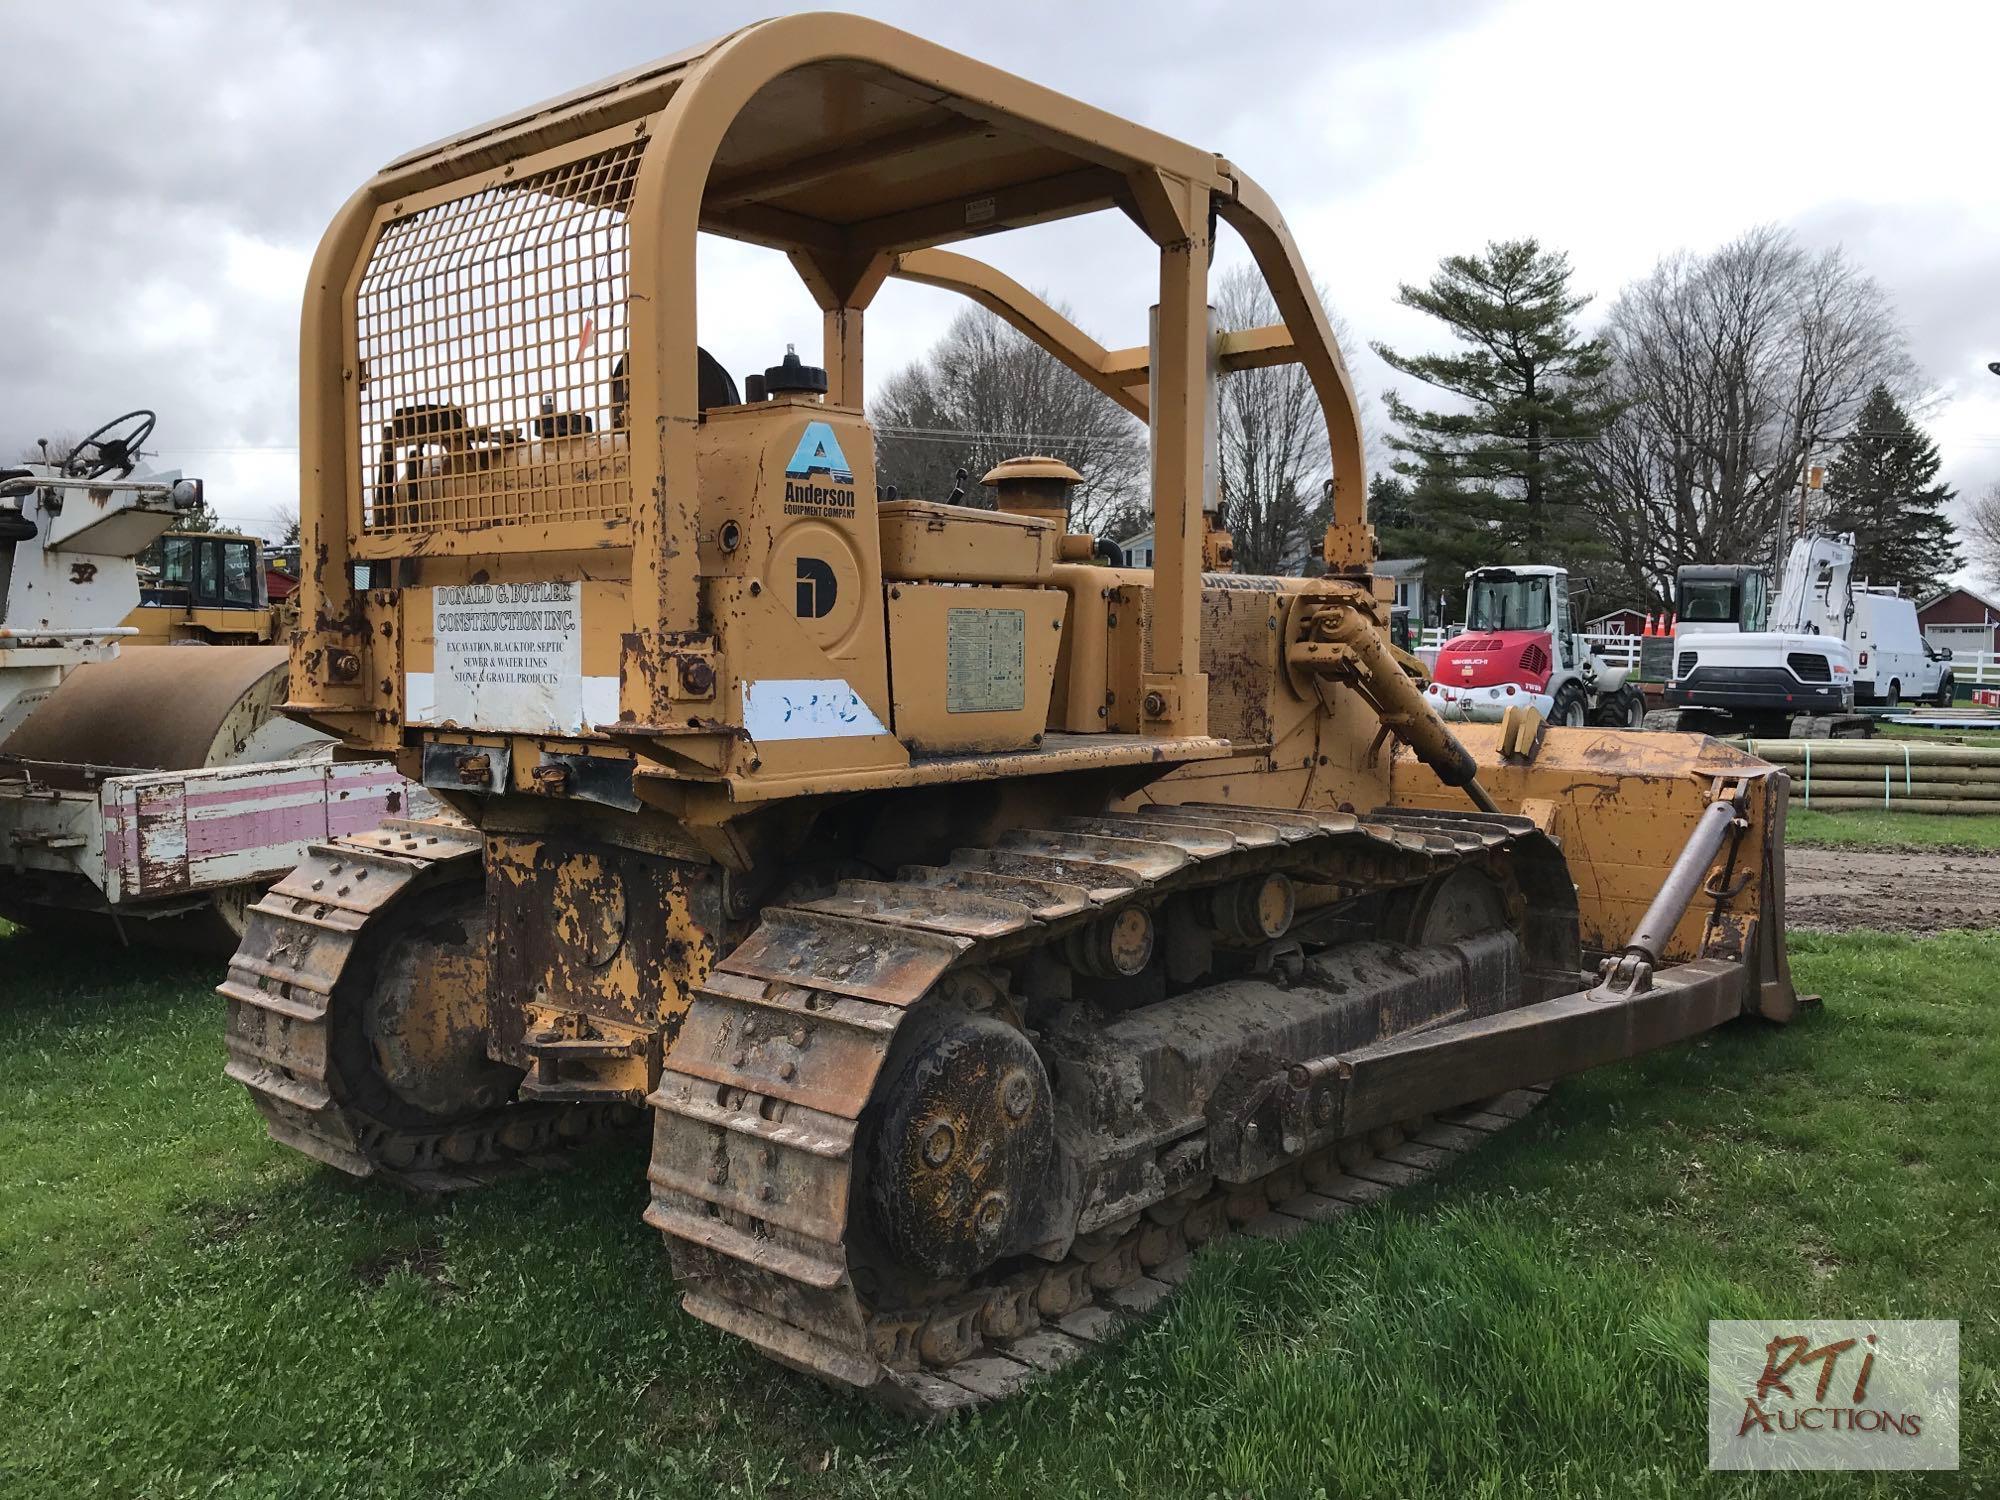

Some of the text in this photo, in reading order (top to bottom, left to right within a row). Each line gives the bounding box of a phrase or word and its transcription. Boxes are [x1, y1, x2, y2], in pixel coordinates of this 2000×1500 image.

[785, 482, 854, 507] Anderson
[784, 504, 855, 519] EQUIPMENT COMPANY
[438, 583, 571, 605] DONALD G. BUTLER
[438, 610, 576, 631] CONSTRUCTION INC.
[447, 642, 564, 652] EXCAVATION, BLACKTOP, SEPTIC
[463, 657, 548, 668] SEWER & WATER LINES
[454, 672, 558, 684] STONE & GRAVEL PRODUCTS
